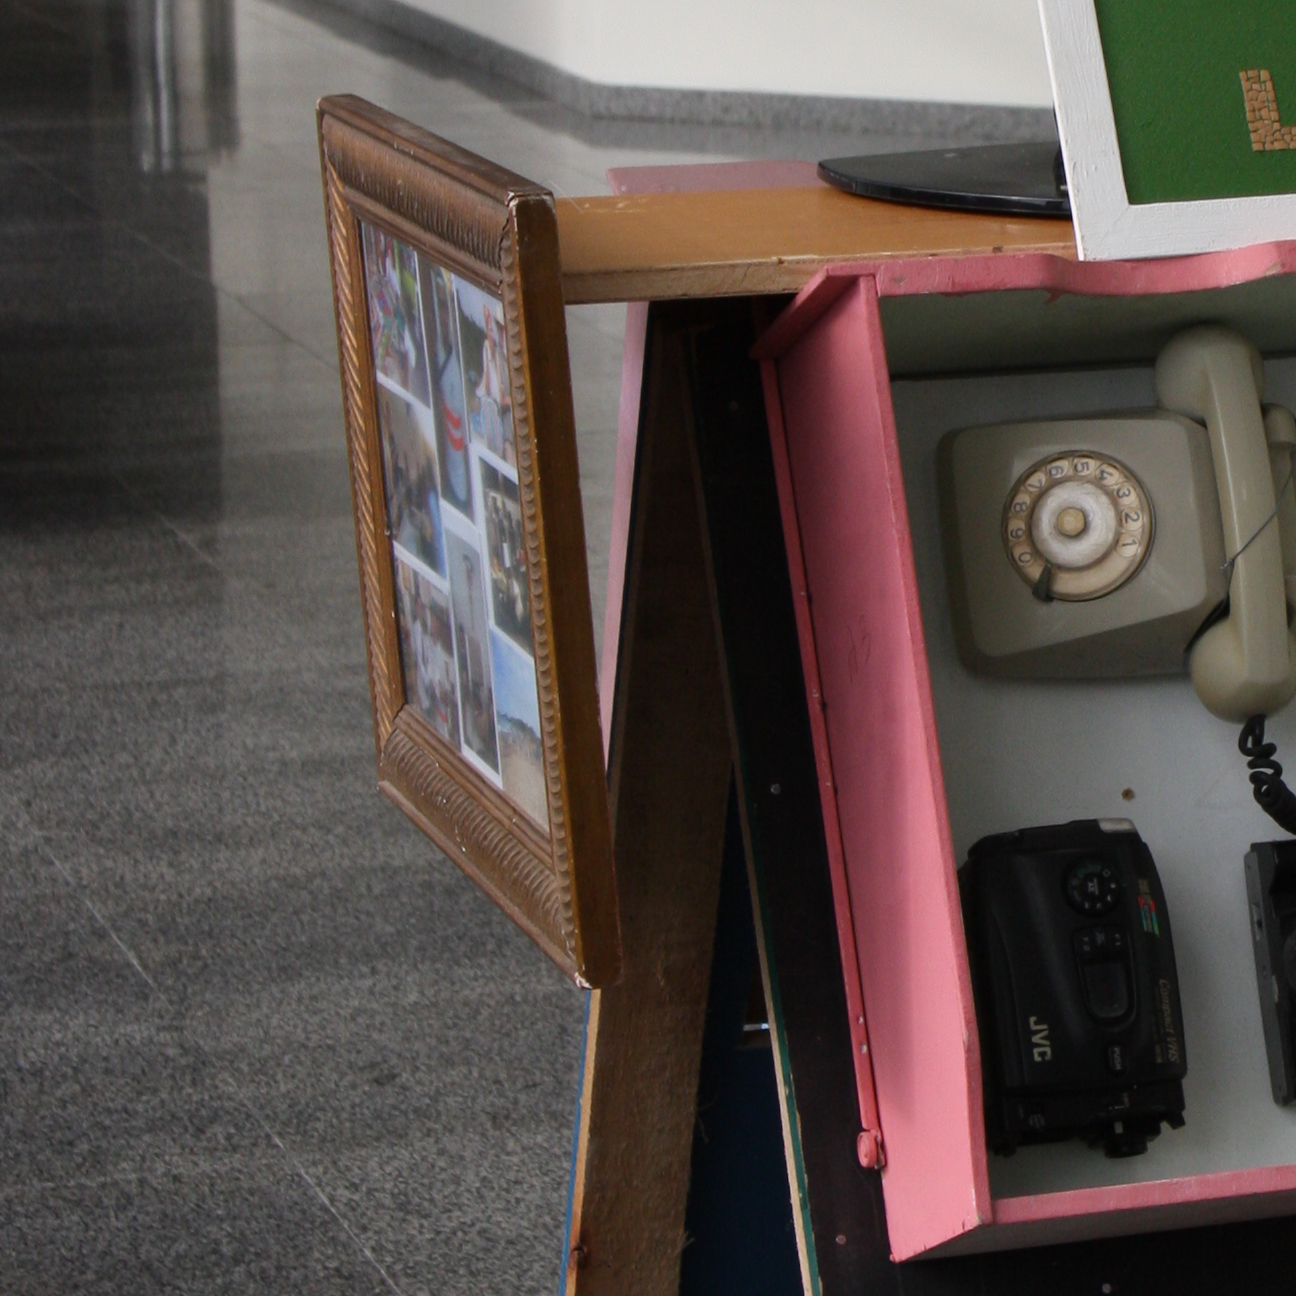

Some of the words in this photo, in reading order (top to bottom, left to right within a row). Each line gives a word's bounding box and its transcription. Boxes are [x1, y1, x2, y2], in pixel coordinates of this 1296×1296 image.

[1049, 465, 1064, 477] 6
[1074, 461, 1089, 473] 5
[1099, 469, 1114, 481] 4
[1028, 478, 1044, 490] 7
[1116, 487, 1131, 499] 3
[1013, 501, 1028, 514] 8
[1124, 511, 1140, 524] 2
[1010, 527, 1025, 540] 9
[1018, 551, 1032, 564] 0
[1028, 1015, 1053, 1063] JVC
